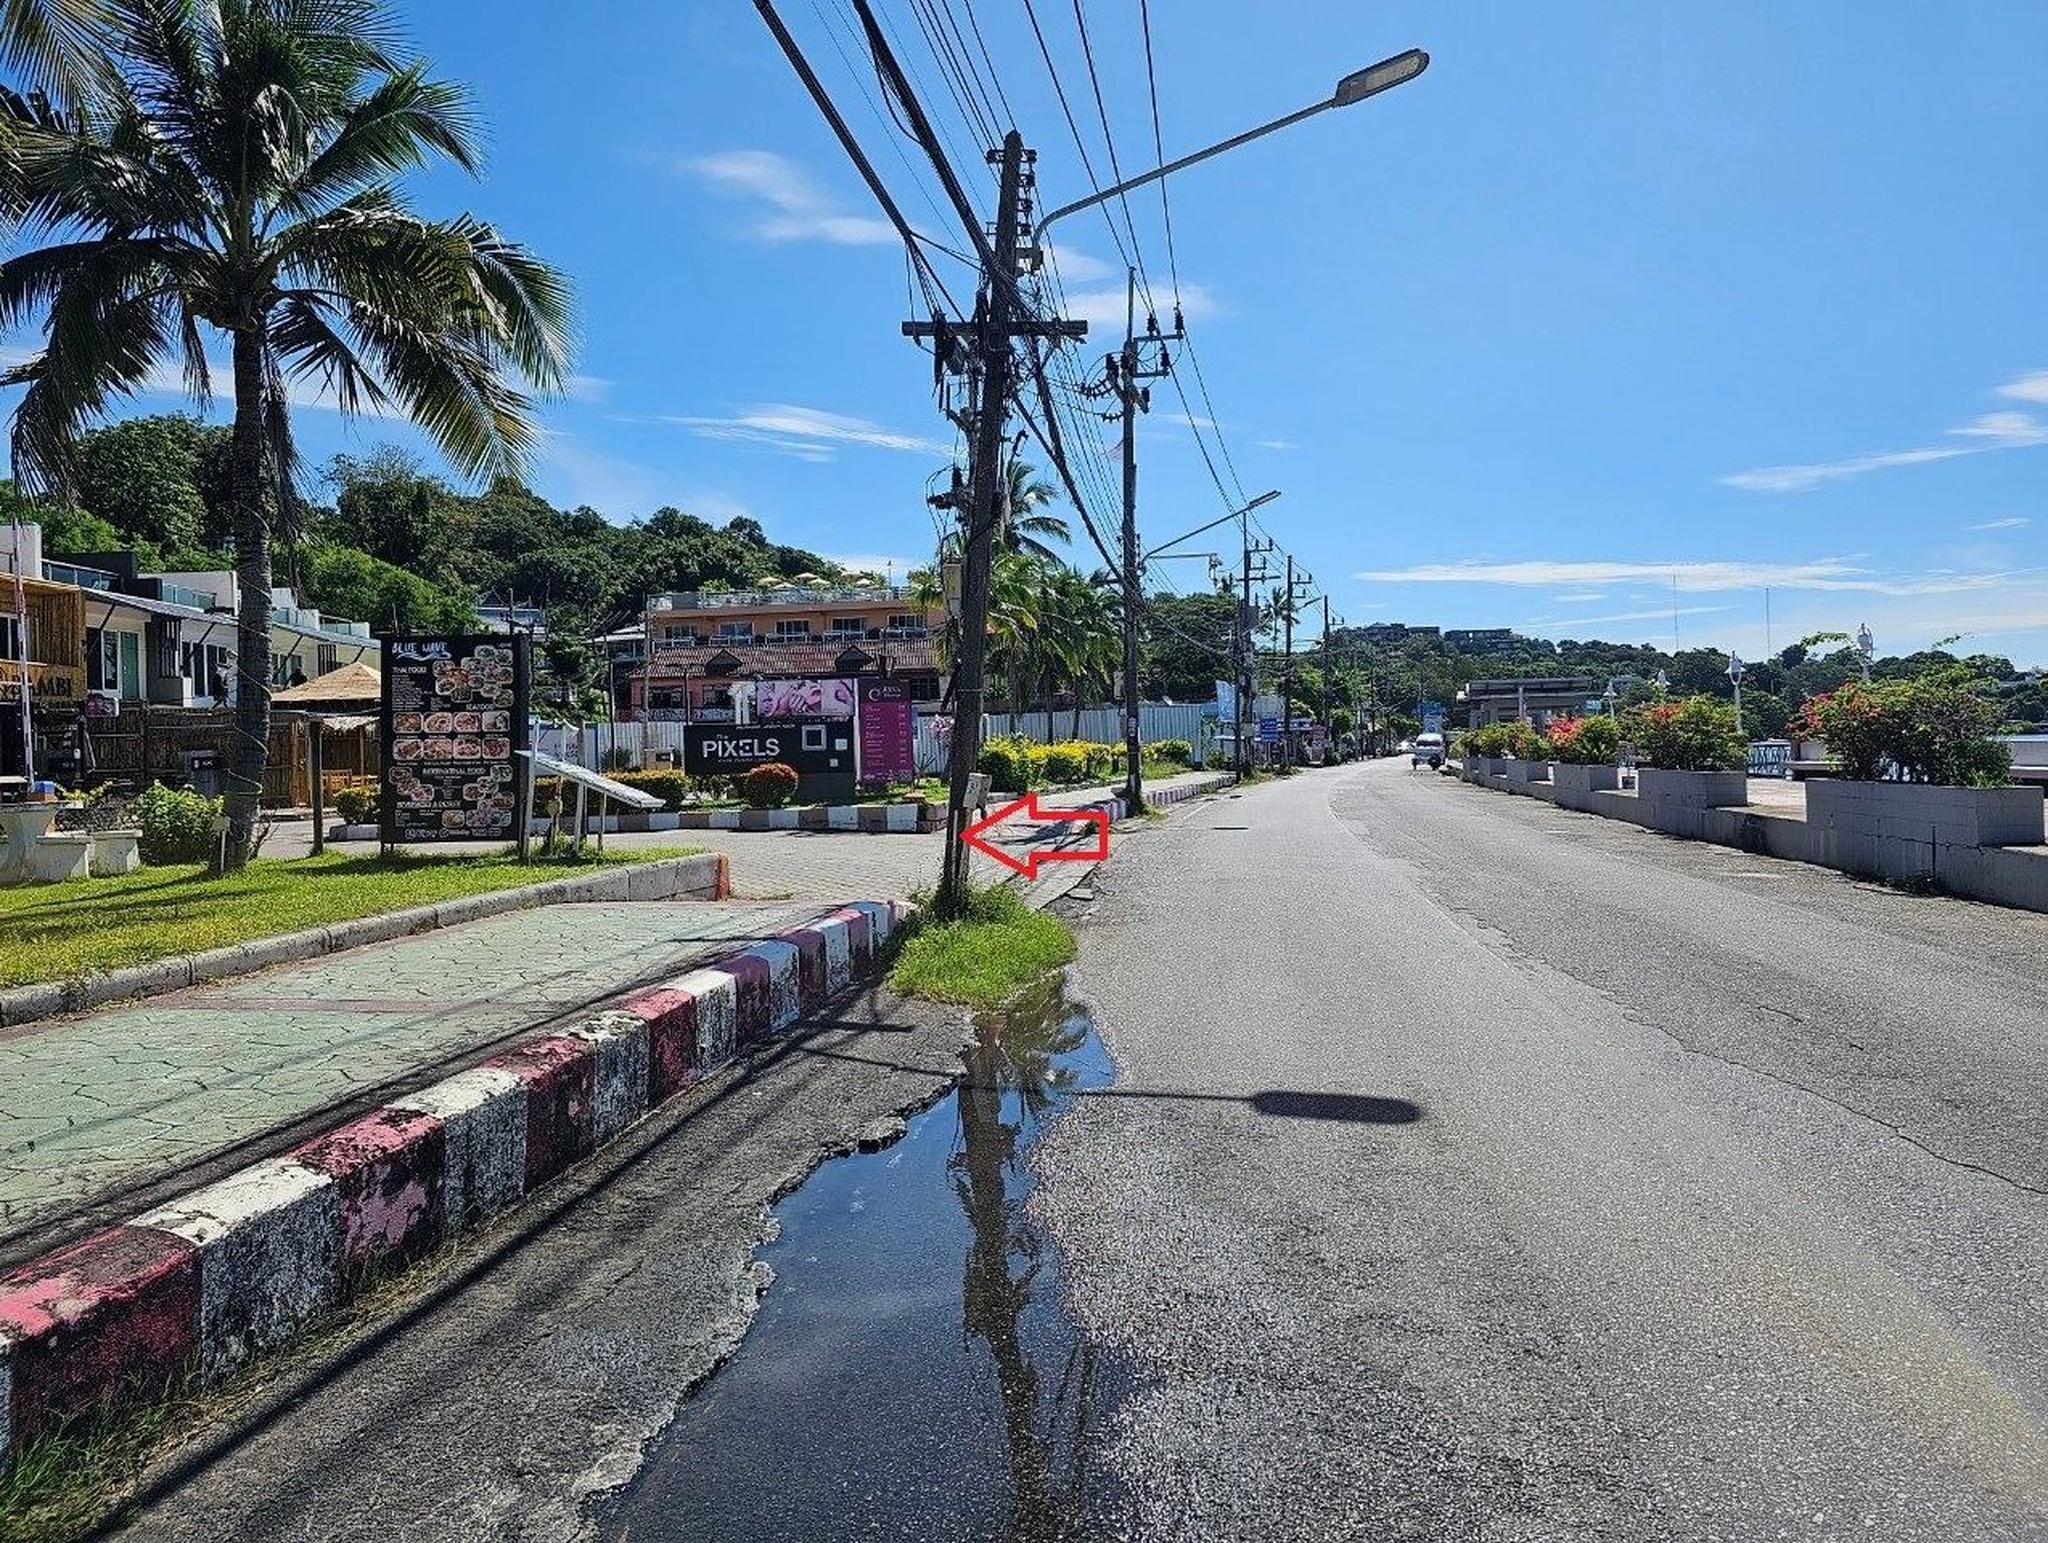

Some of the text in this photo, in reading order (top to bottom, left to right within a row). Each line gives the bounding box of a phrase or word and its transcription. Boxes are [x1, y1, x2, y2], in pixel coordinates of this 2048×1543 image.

[392, 642, 447, 653] BLUE WAVE
[702, 738, 781, 758] PIXELS
